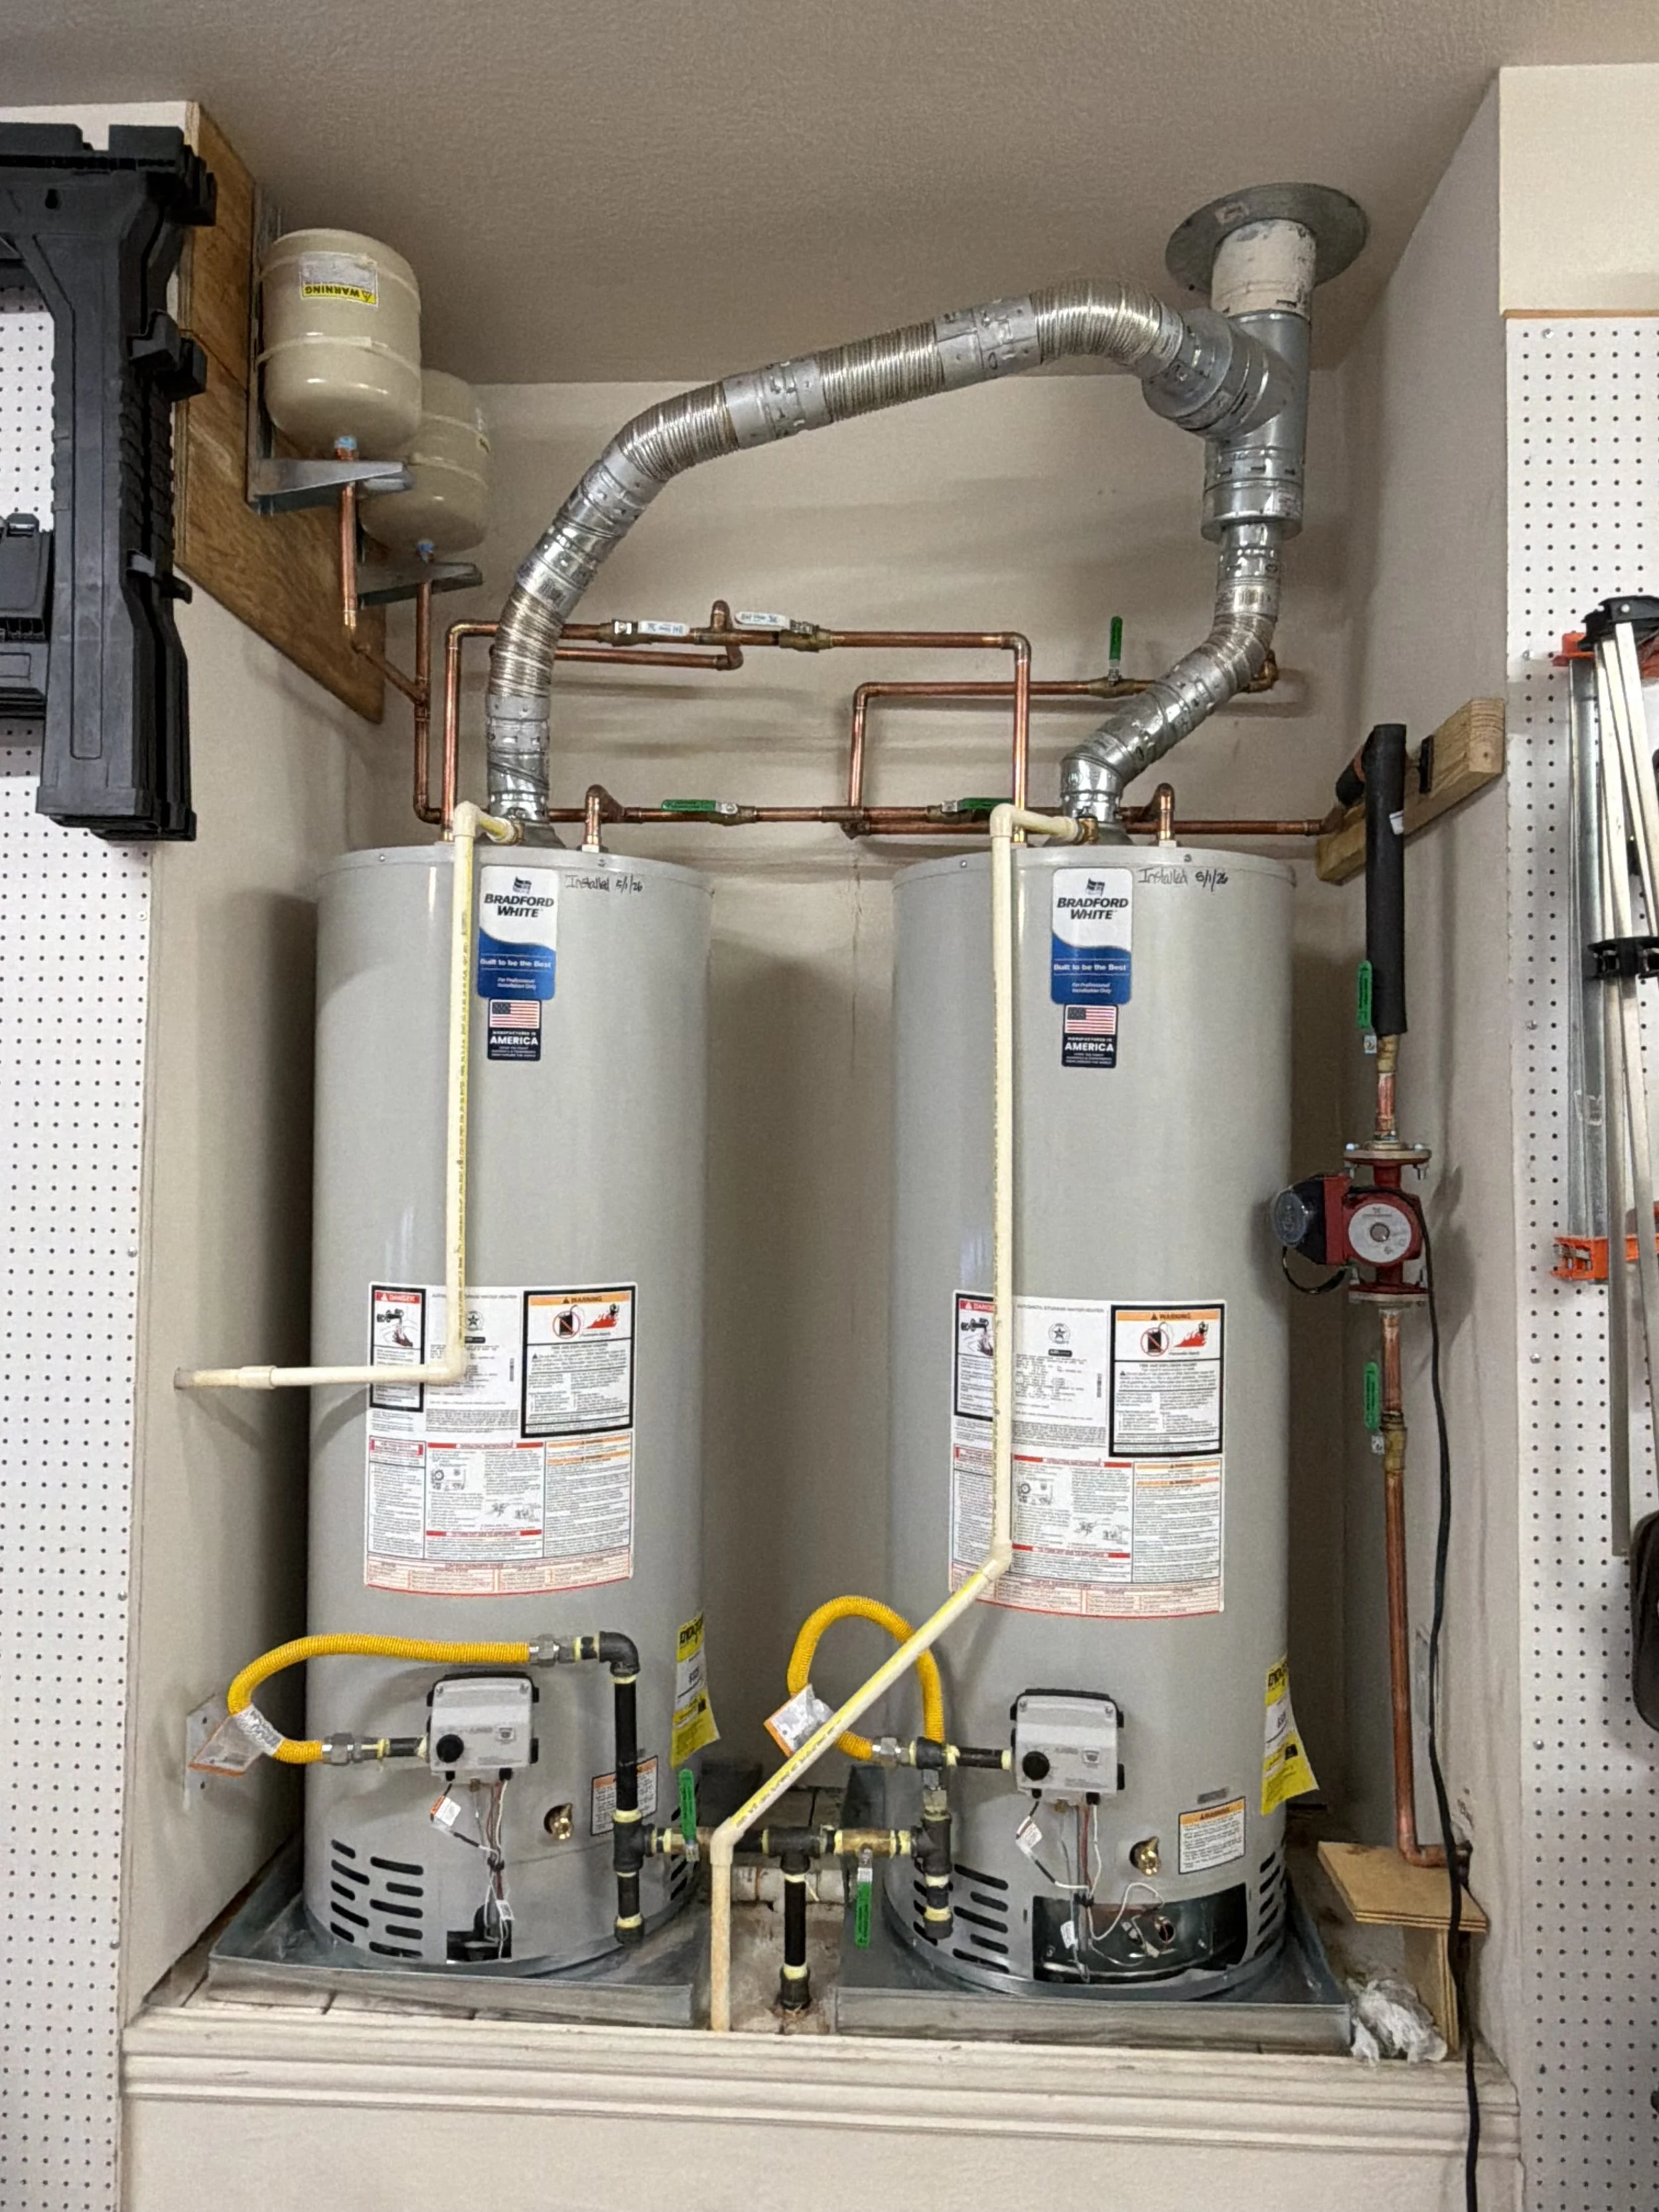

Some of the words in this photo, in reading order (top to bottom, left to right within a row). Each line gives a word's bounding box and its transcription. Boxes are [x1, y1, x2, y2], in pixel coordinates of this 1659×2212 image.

[305, 285, 360, 297] WARNING
[484, 893, 555, 907] BRADFORD
[1056, 897, 1129, 908] BRADFORD
[497, 905, 540, 918] WHITE
[1070, 909, 1114, 920] WHITE
[490, 1035, 539, 1045] AMERICA
[1064, 1042, 1114, 1052] AMERICA
